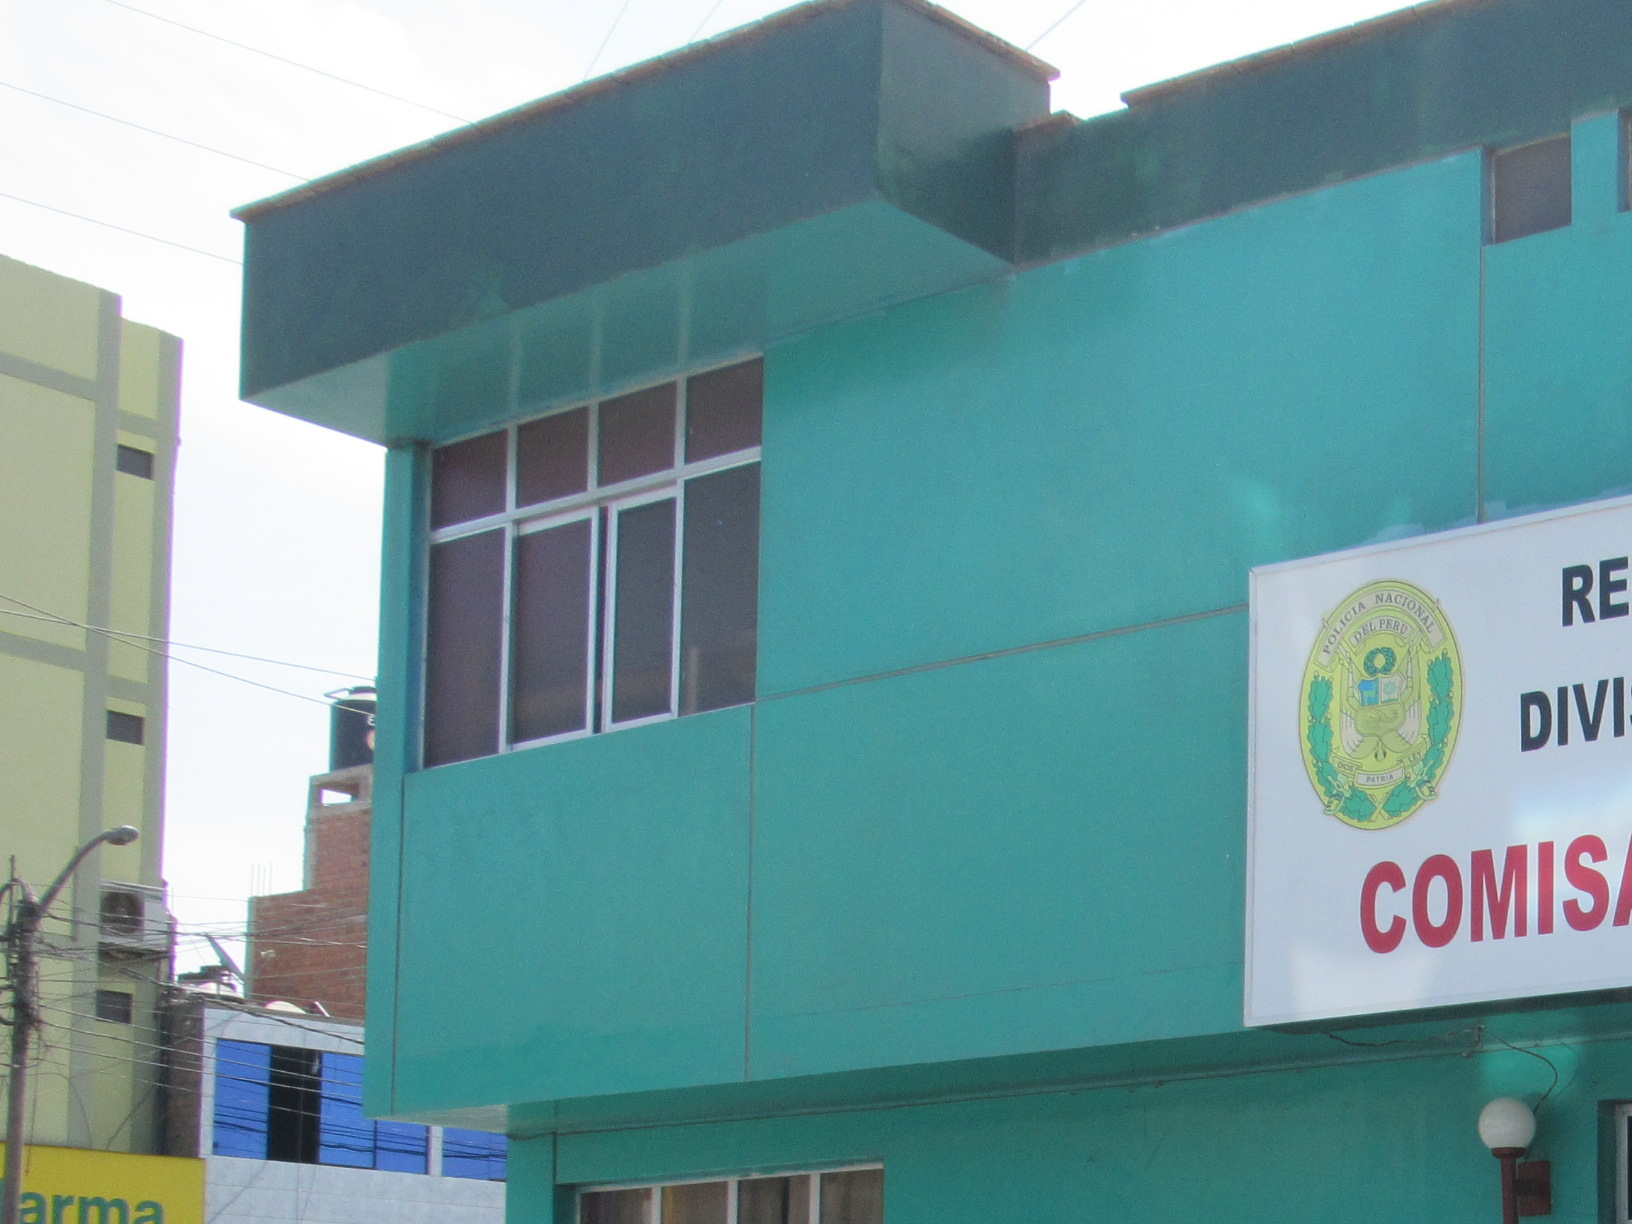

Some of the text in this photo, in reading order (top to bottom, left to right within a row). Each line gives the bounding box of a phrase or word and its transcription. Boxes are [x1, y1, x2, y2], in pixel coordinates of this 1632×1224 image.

[1322, 592, 1436, 656] POLICIA NACIONAL
[1354, 618, 1409, 643] DEL PERU
[1337, 760, 1355, 773] DIOS
[1364, 773, 1394, 784] PATRIA
